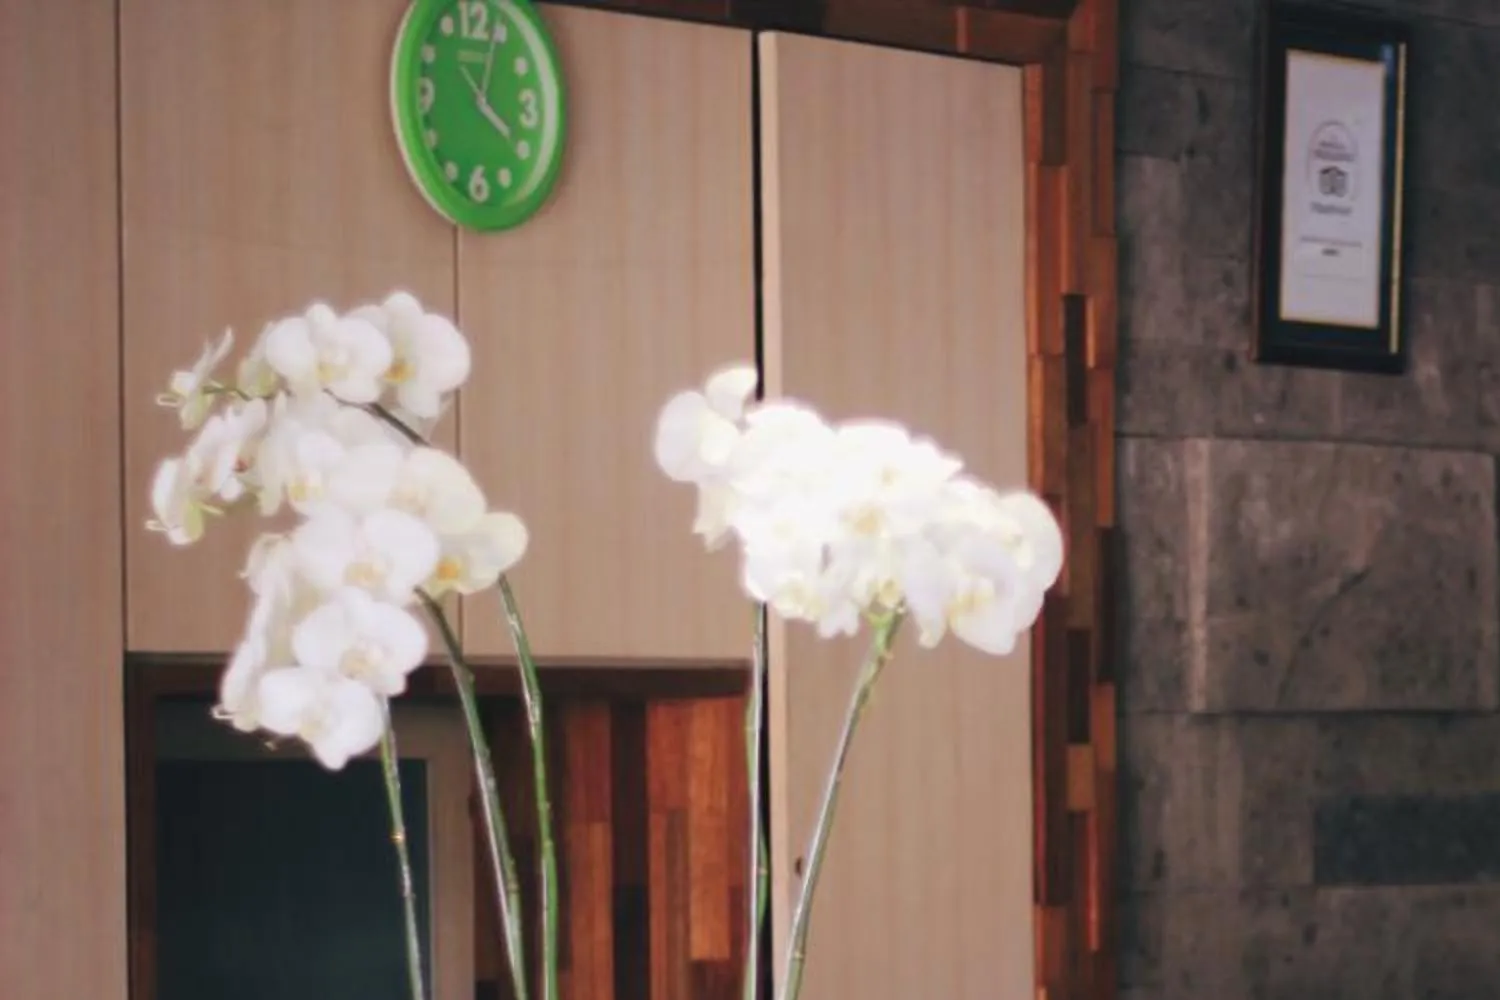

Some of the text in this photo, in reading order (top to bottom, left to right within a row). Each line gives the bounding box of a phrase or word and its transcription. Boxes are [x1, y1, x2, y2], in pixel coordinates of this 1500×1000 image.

[459, 0, 490, 41] 12
[519, 87, 539, 129] 3
[468, 164, 490, 204] 6
